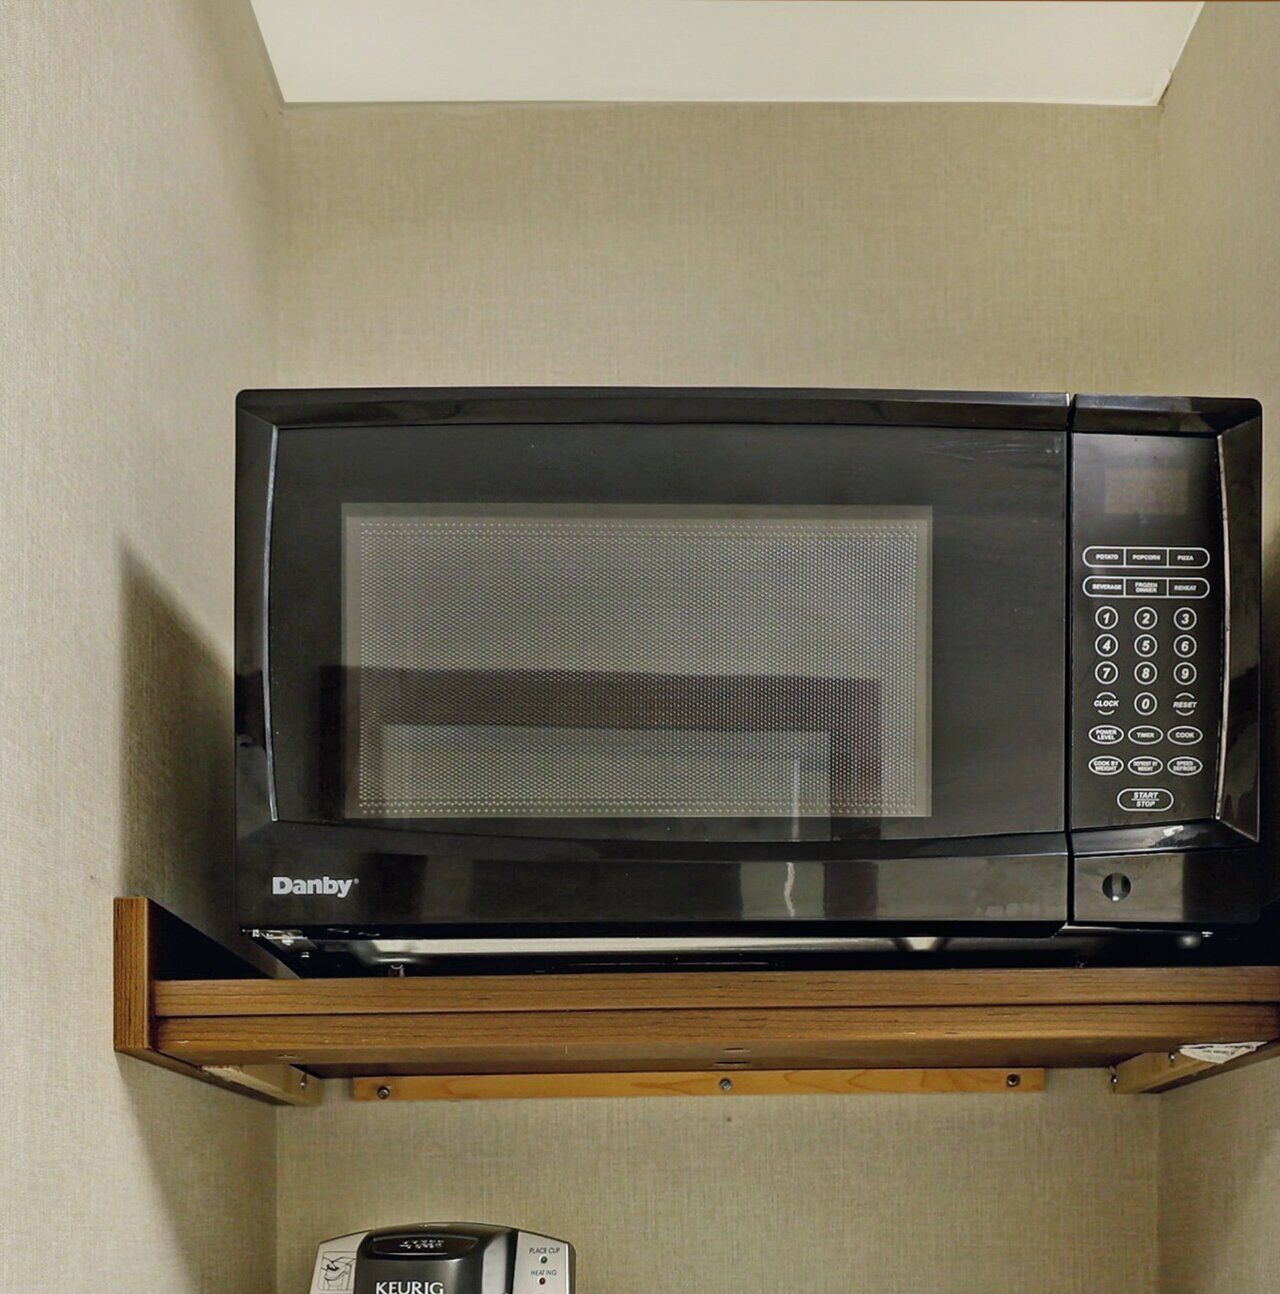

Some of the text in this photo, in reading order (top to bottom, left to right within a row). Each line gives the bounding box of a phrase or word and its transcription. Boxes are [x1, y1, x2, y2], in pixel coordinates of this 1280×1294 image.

[1103, 612, 1110, 624] 1
[1141, 613, 1150, 624] 2
[1181, 613, 1189, 624] 3
[1102, 640, 1111, 651] 4
[1141, 640, 1150, 651] 5
[1181, 641, 1189, 652] 6
[1103, 667, 1111, 679] 7
[1141, 668, 1150, 679] 8
[1181, 668, 1189, 679] 9
[1141, 698, 1150, 709] 0
[272, 876, 353, 898] Danby
